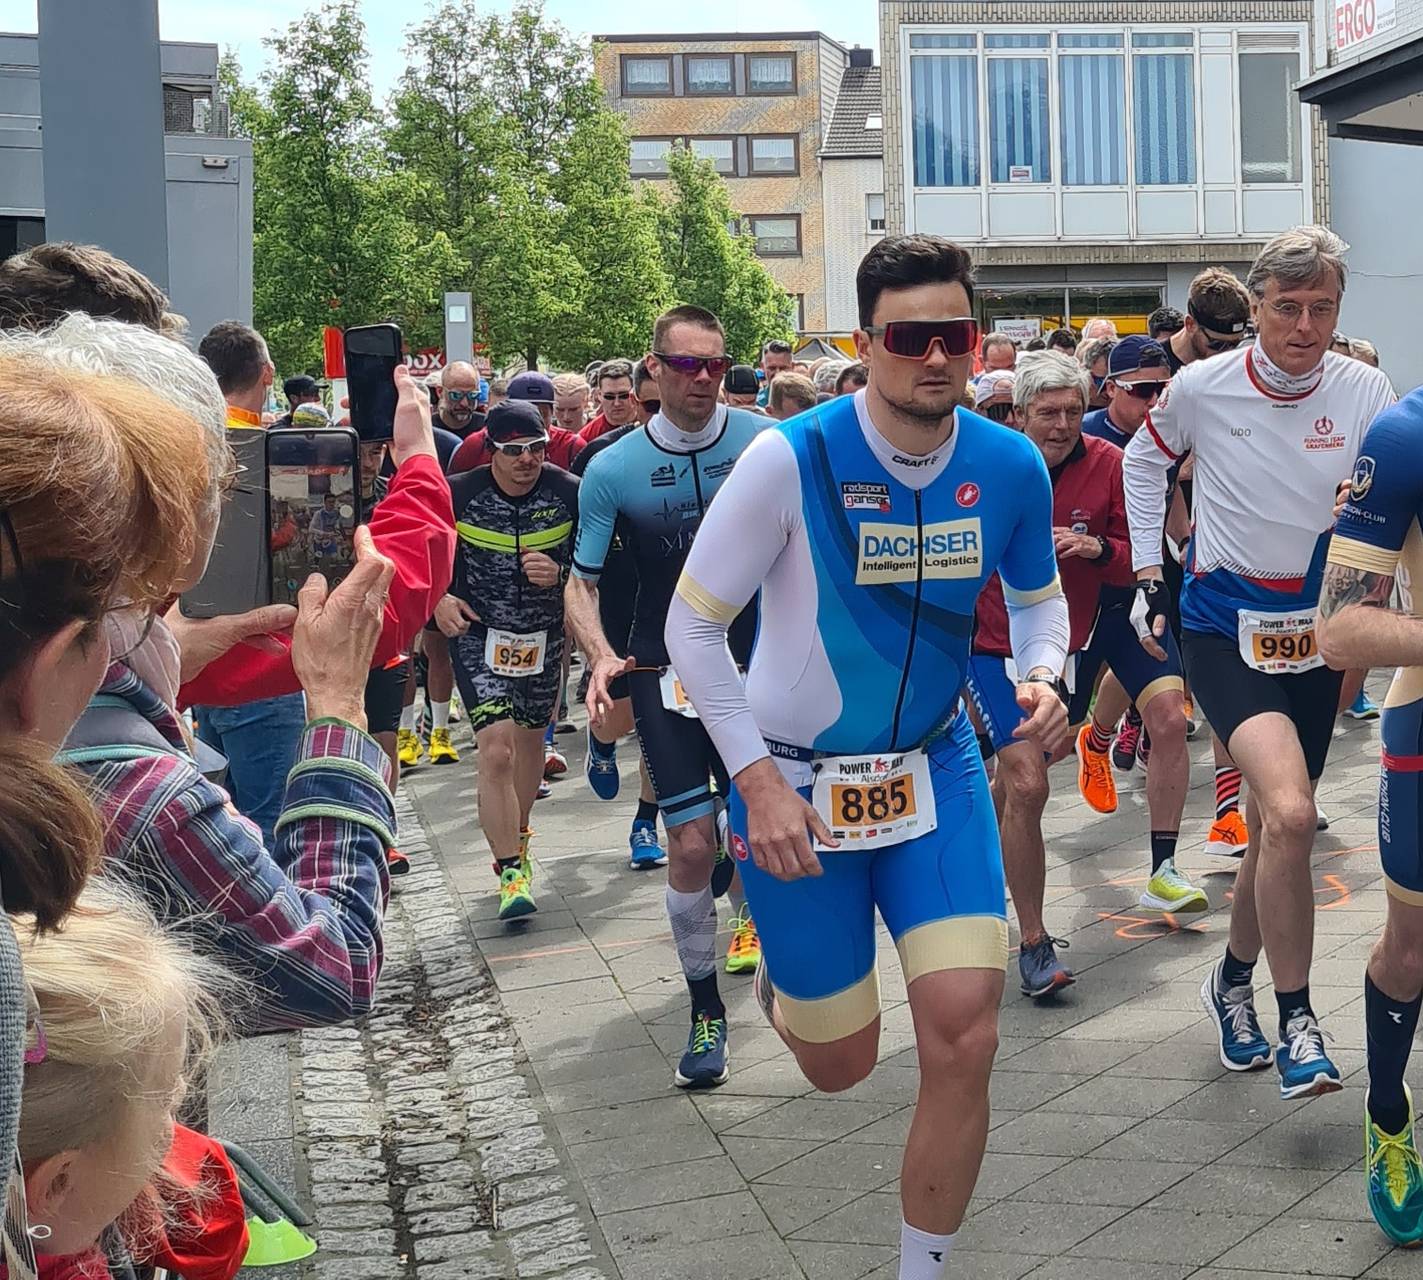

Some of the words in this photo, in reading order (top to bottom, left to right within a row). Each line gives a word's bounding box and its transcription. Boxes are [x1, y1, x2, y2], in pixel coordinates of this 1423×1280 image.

[1336, 0, 1375, 48] ERGO
[1230, 427, 1252, 437] UDO
[892, 454, 931, 468] CRAFT
[843, 483, 888, 494] radsport
[863, 530, 978, 558] DACHSER
[862, 560, 917, 572] Intelligent
[924, 555, 979, 567] Logistics
[1259, 620, 1285, 629] POWER
[1260, 634, 1312, 659] 990
[500, 648, 534, 666] 954
[839, 761, 872, 775] POWER
[841, 780, 908, 823] 885
